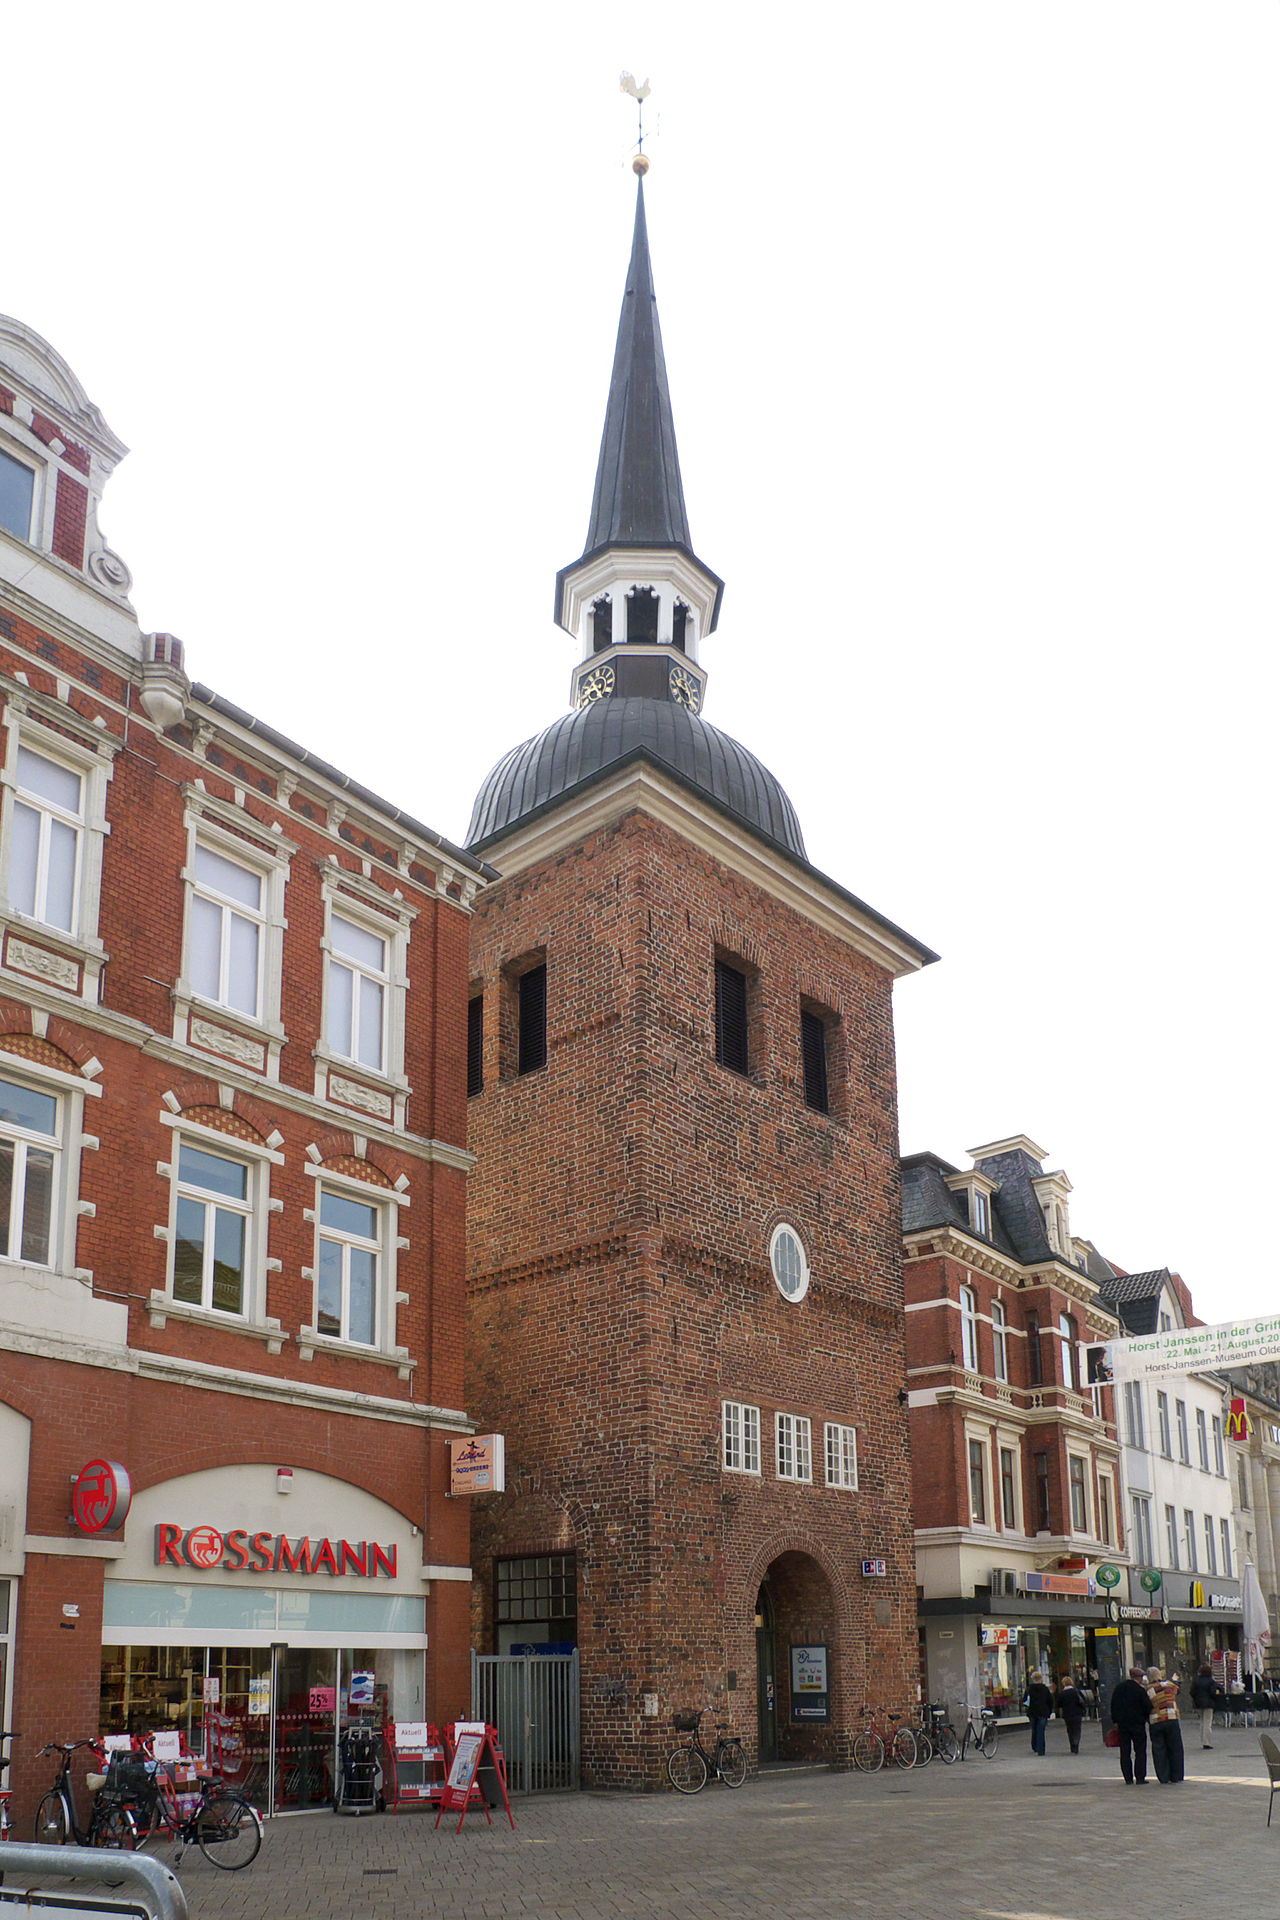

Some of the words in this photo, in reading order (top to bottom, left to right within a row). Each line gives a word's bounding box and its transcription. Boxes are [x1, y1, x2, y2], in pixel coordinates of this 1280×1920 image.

[1128, 1340, 1160, 1352] Horst
[1164, 1332, 1212, 1348] Janssen
[1217, 1329, 1227, 1339] in
[1230, 1327, 1250, 1337] der
[1166, 1350, 1181, 1359] 22.
[1184, 1346, 1200, 1356] Mai
[1210, 1343, 1225, 1353] 21.
[1227, 1336, 1265, 1350] August
[1145, 1350, 1257, 1373] Horst-Janssen-Museum
[155, 1523, 397, 1579] ROSSMANN
[310, 1693, 328, 1708] 25%
